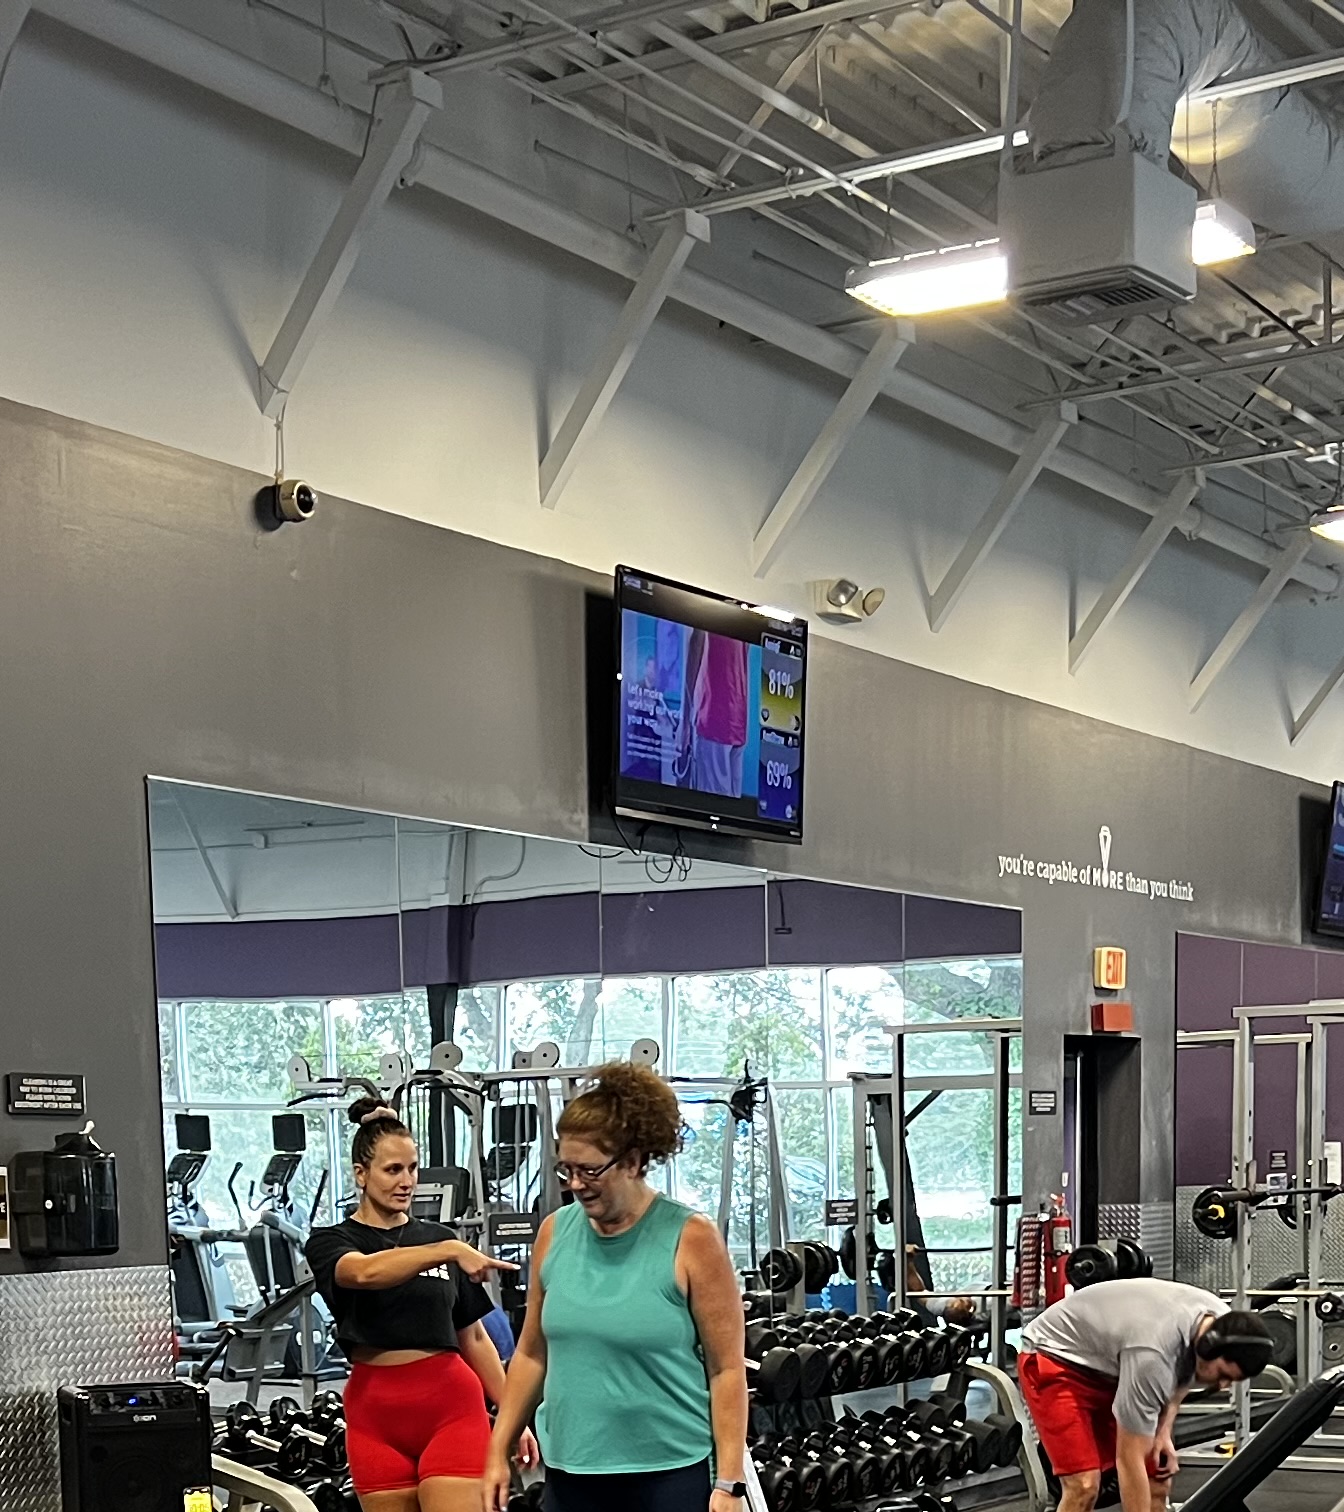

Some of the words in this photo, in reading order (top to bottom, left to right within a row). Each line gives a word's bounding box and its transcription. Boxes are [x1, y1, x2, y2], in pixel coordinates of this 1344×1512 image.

[768, 668, 795, 700] 81%
[766, 760, 792, 789] 69%
[998, 854, 1035, 878] you're
[1036, 861, 1078, 885] capable
[1079, 865, 1091, 886] of
[1125, 872, 1149, 895] than
[1149, 881, 1168, 901] you
[1169, 879, 1194, 902] think
